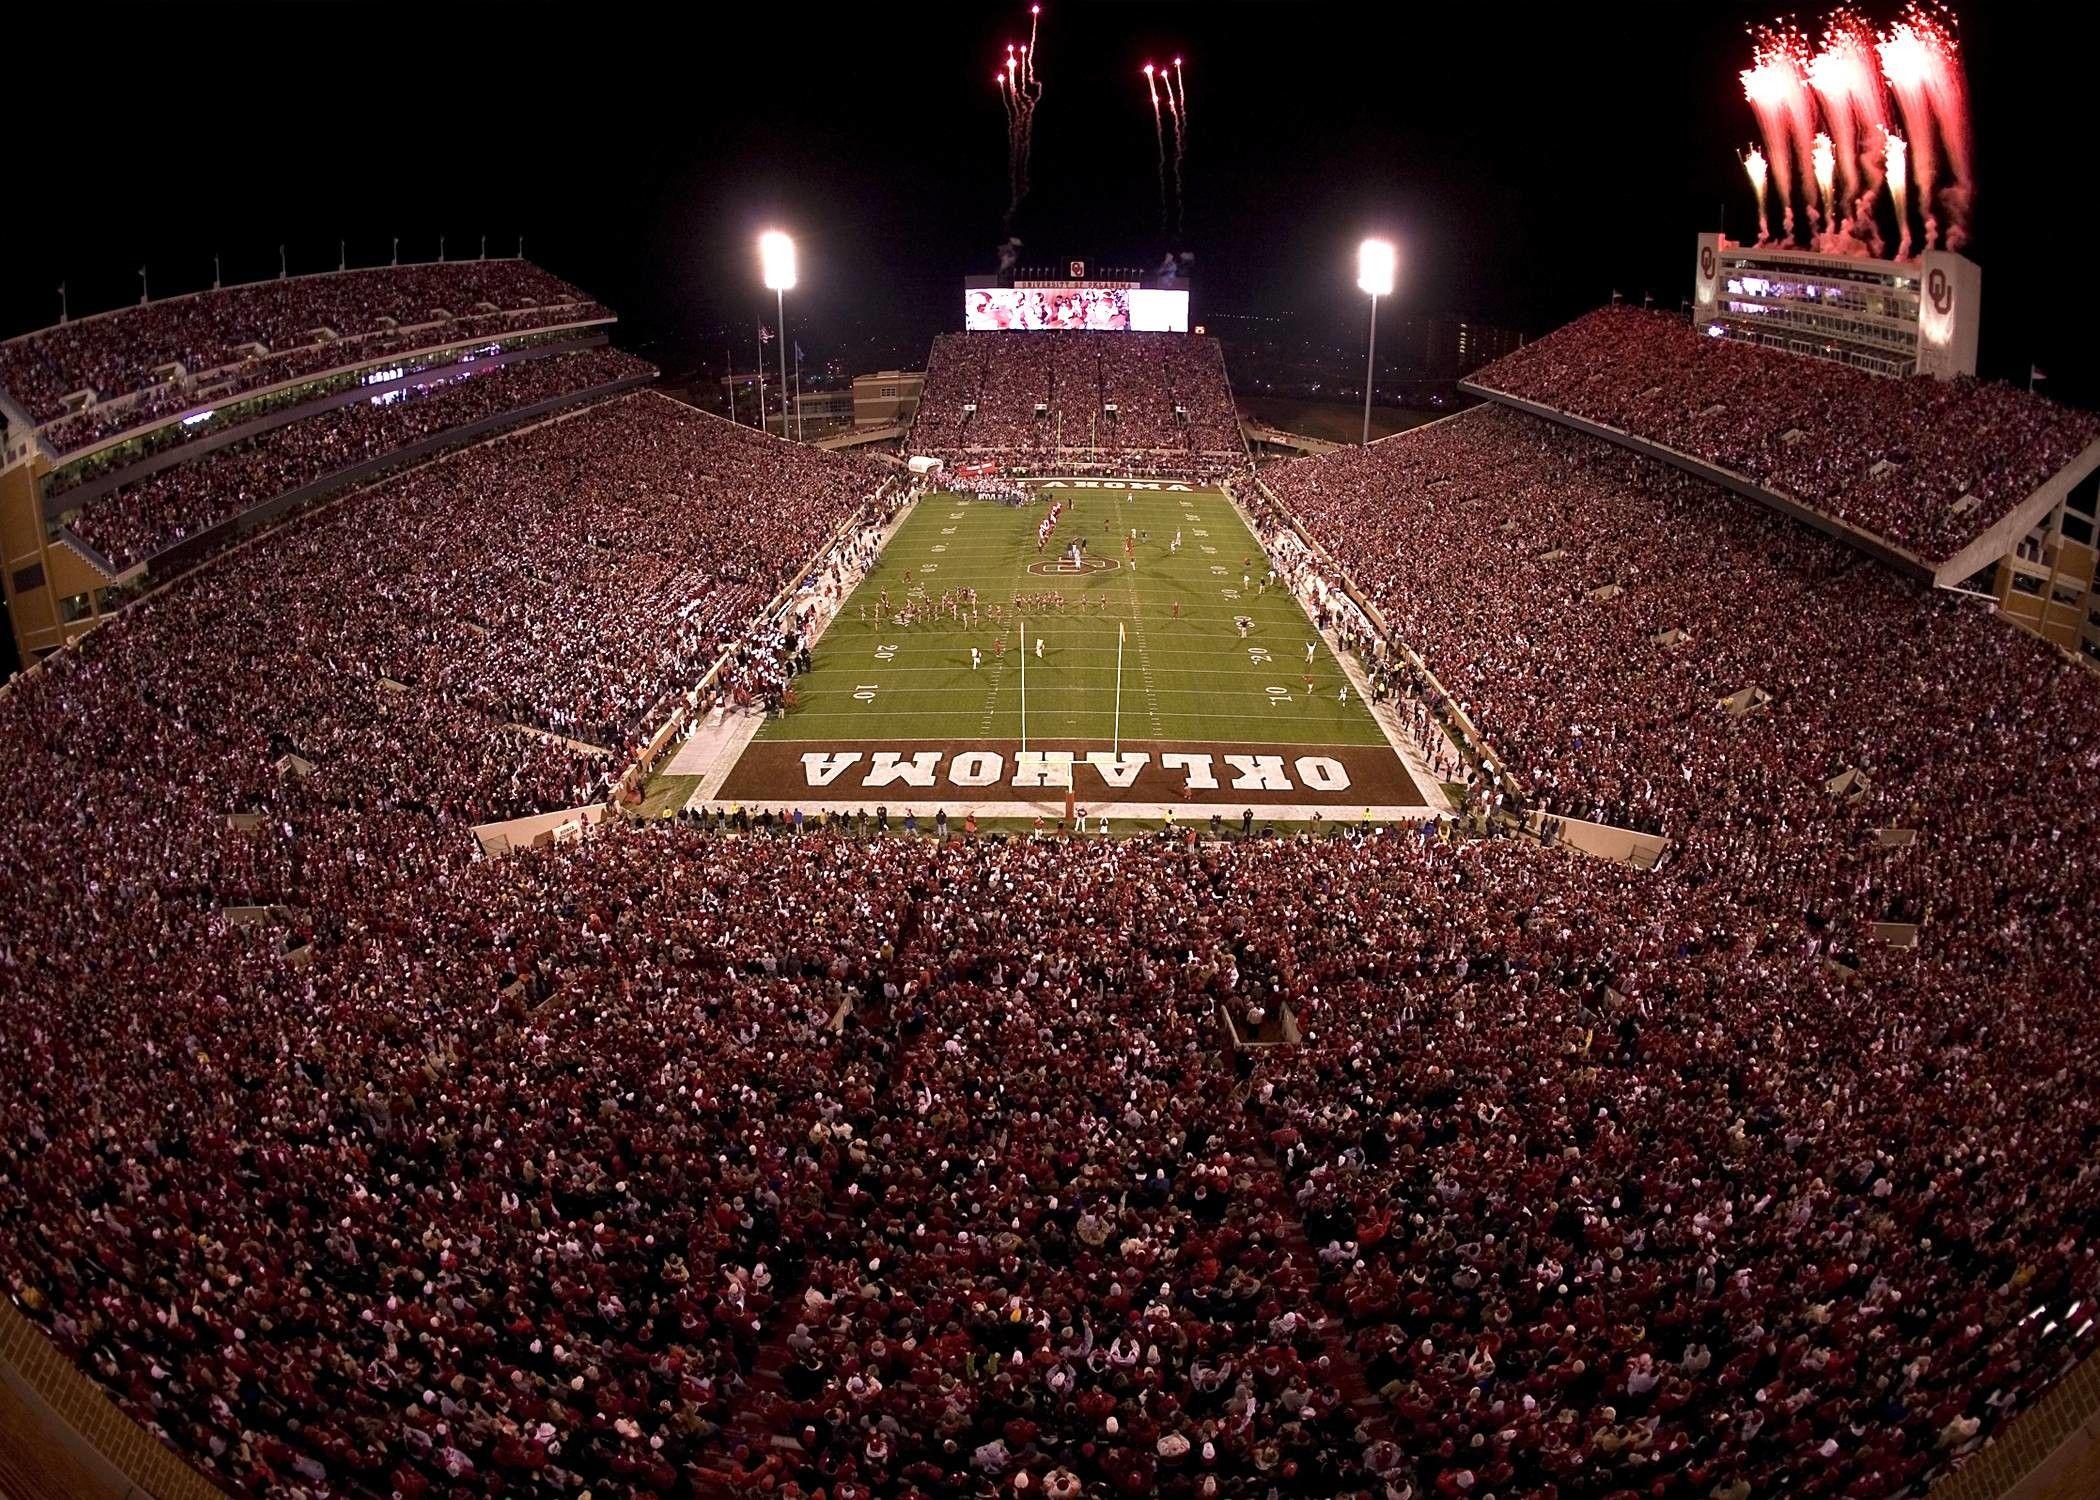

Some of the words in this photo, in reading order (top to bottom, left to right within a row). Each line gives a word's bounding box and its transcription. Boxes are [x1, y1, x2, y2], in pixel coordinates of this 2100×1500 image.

[1071, 263, 1083, 276] OU
[1701, 246, 1716, 280] OU
[1929, 268, 1951, 315] OU
[874, 644, 898, 659] 20
[1248, 647, 1272, 662] 20
[853, 684, 878, 699] 10
[1265, 687, 1292, 702] 10
[800, 751, 1352, 792] OKLAHOMA
